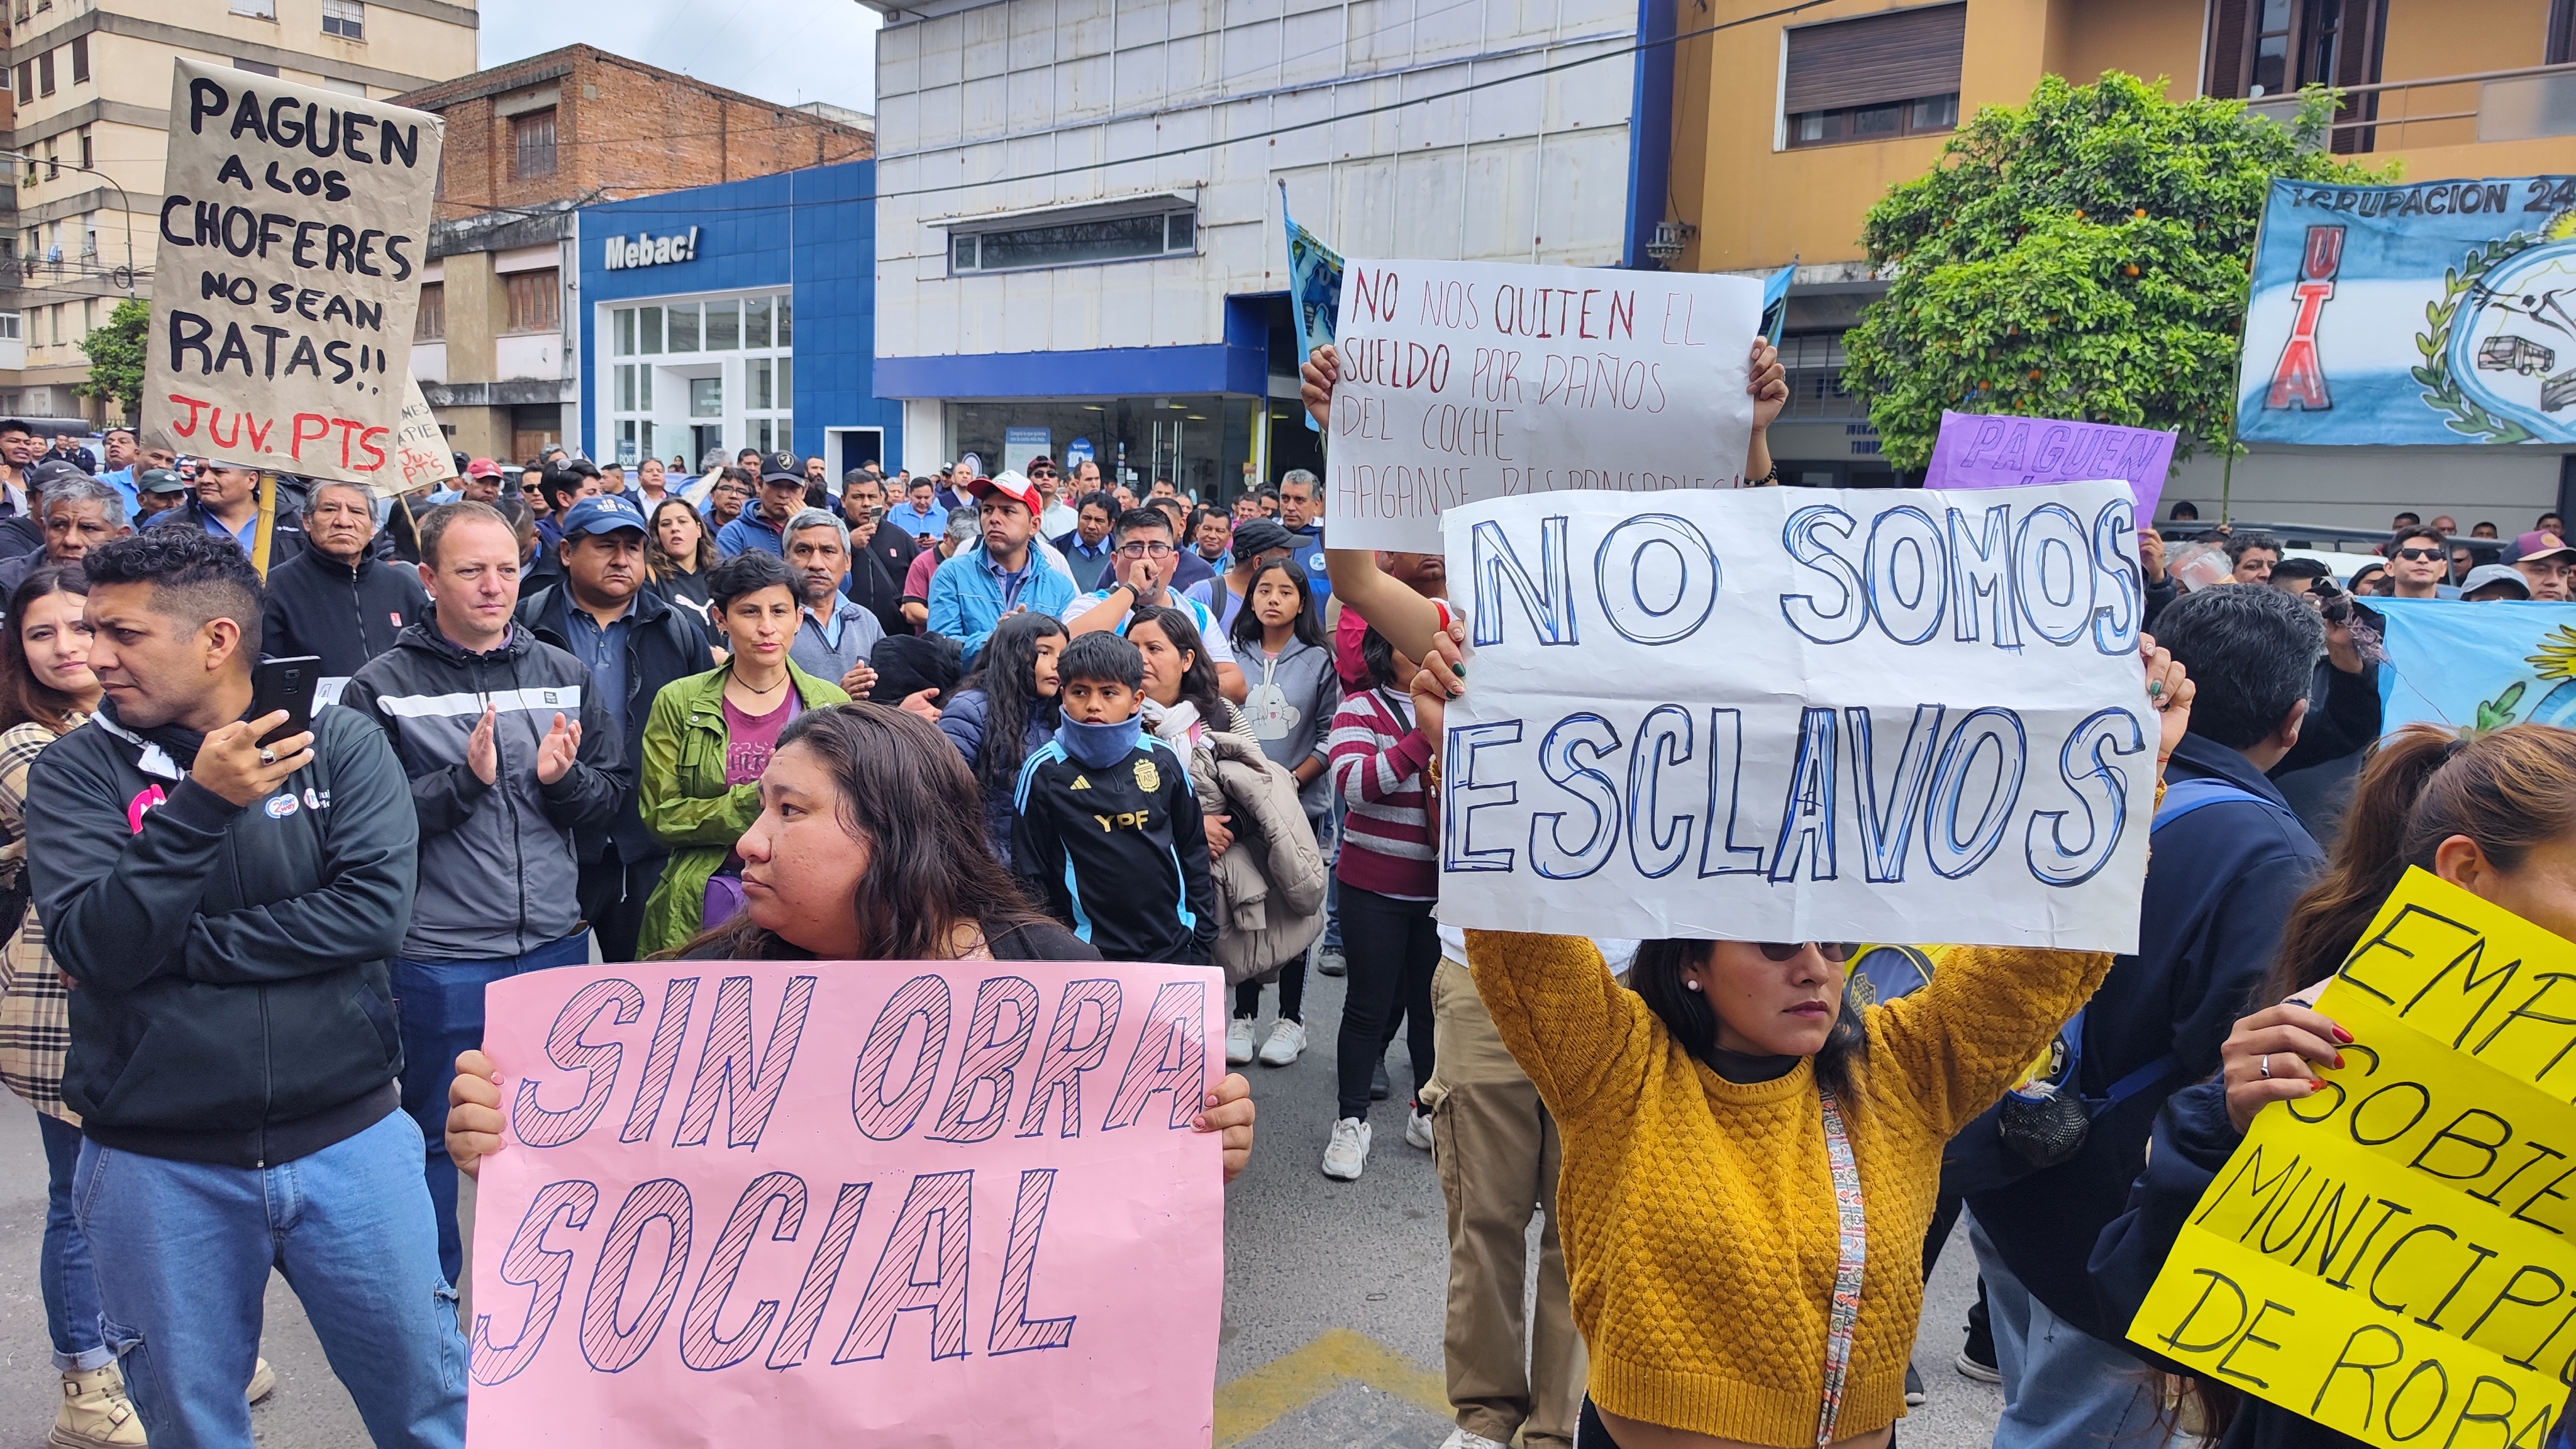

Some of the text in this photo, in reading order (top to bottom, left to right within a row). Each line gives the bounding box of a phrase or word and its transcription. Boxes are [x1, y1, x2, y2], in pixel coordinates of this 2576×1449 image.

[189, 78, 418, 168] PAGUEN
[217, 154, 352, 201] A LOS
[160, 195, 413, 282] CHOFERES
[604, 225, 700, 270] Mebac!
[201, 270, 384, 333] NO SEAN
[1352, 266, 1707, 347] NO NOS QUITEN EL
[2262, 224, 2348, 413] UTA
[169, 309, 386, 396] RATAS!!
[1342, 336, 1666, 414] SUELDO POR DAÑOS
[168, 394, 390, 472] JUV. PTS
[401, 402, 430, 421] NES
[1341, 394, 1514, 462] DEL COCHE
[1960, 419, 2164, 483] PAGUEN
[403, 458, 445, 485] PTS
[1338, 464, 1472, 519] HAGANSE
[1472, 497, 2141, 657] NO SOMOS
[1093, 809, 1150, 833] YPF
[1444, 702, 2145, 887] ESCLAVOS
[2338, 903, 2576, 1084] EMP
[512, 973, 1207, 1153] SIN OBRA
[469, 1167, 1078, 1387] SOCIAL
[2195, 1143, 2576, 1387] MUNICIPI
[2157, 1267, 2297, 1390] DE
